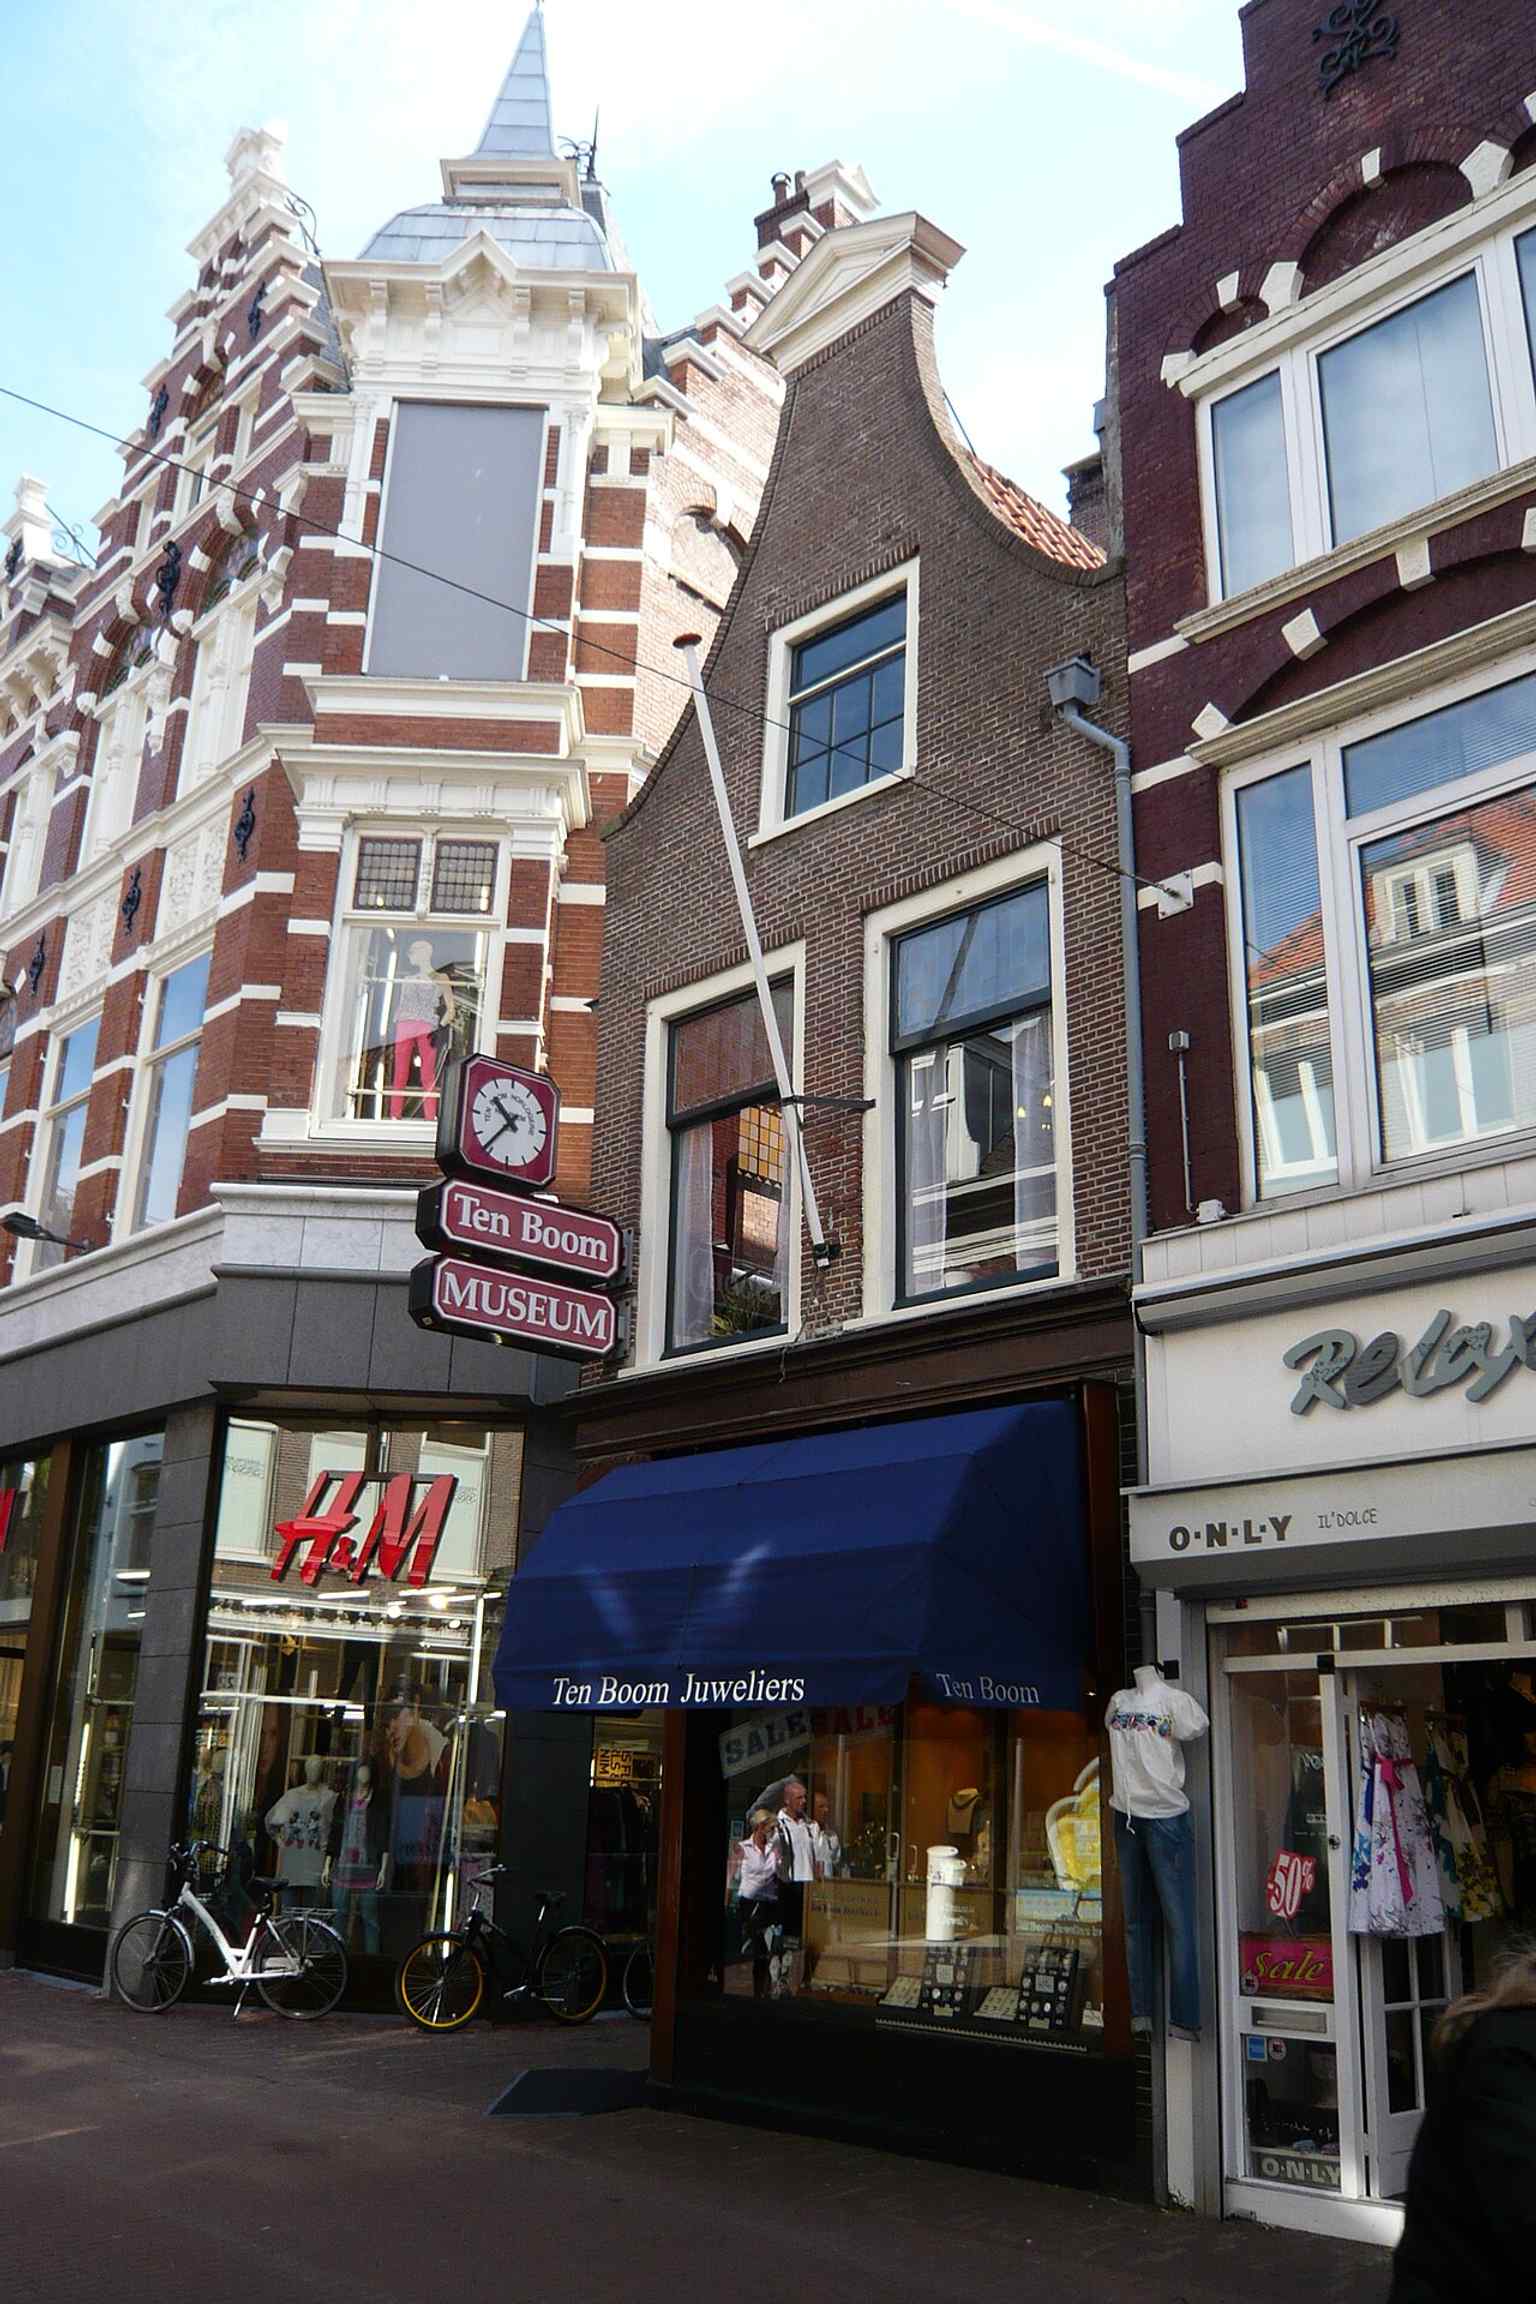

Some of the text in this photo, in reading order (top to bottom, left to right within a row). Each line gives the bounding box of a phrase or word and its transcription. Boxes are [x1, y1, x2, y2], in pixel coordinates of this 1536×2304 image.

[454, 1193, 608, 1262] Ten Boom
[442, 1271, 608, 1341] MUSEUM
[1283, 1309, 1536, 1416] Relax
[271, 1471, 459, 1588] H&M
[553, 1669, 805, 1705] Ten Boom Juweliers
[936, 1673, 1040, 1703] Ten Boom
[724, 1711, 804, 1765] SALE
[1267, 1854, 1316, 1918] -50%
[1252, 1948, 1326, 1982] Sale
